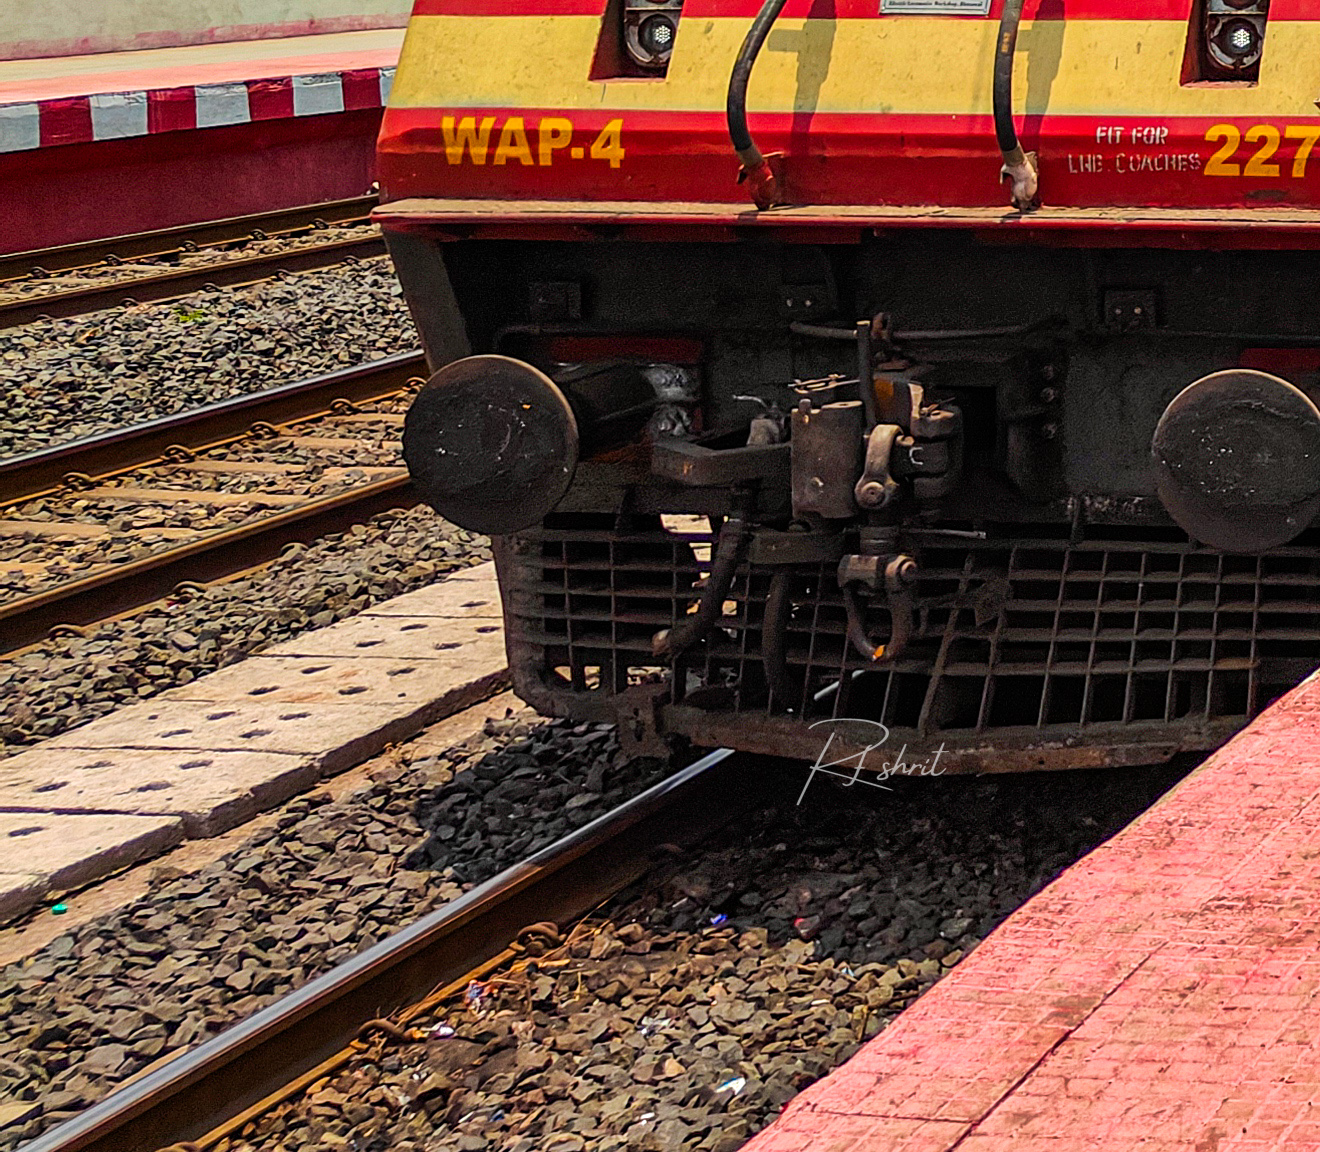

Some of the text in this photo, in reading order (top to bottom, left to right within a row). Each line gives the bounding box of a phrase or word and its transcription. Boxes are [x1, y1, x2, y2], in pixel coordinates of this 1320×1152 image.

[1096, 126, 1169, 145] FIT FOR
[1115, 152, 1201, 173] COACHES
